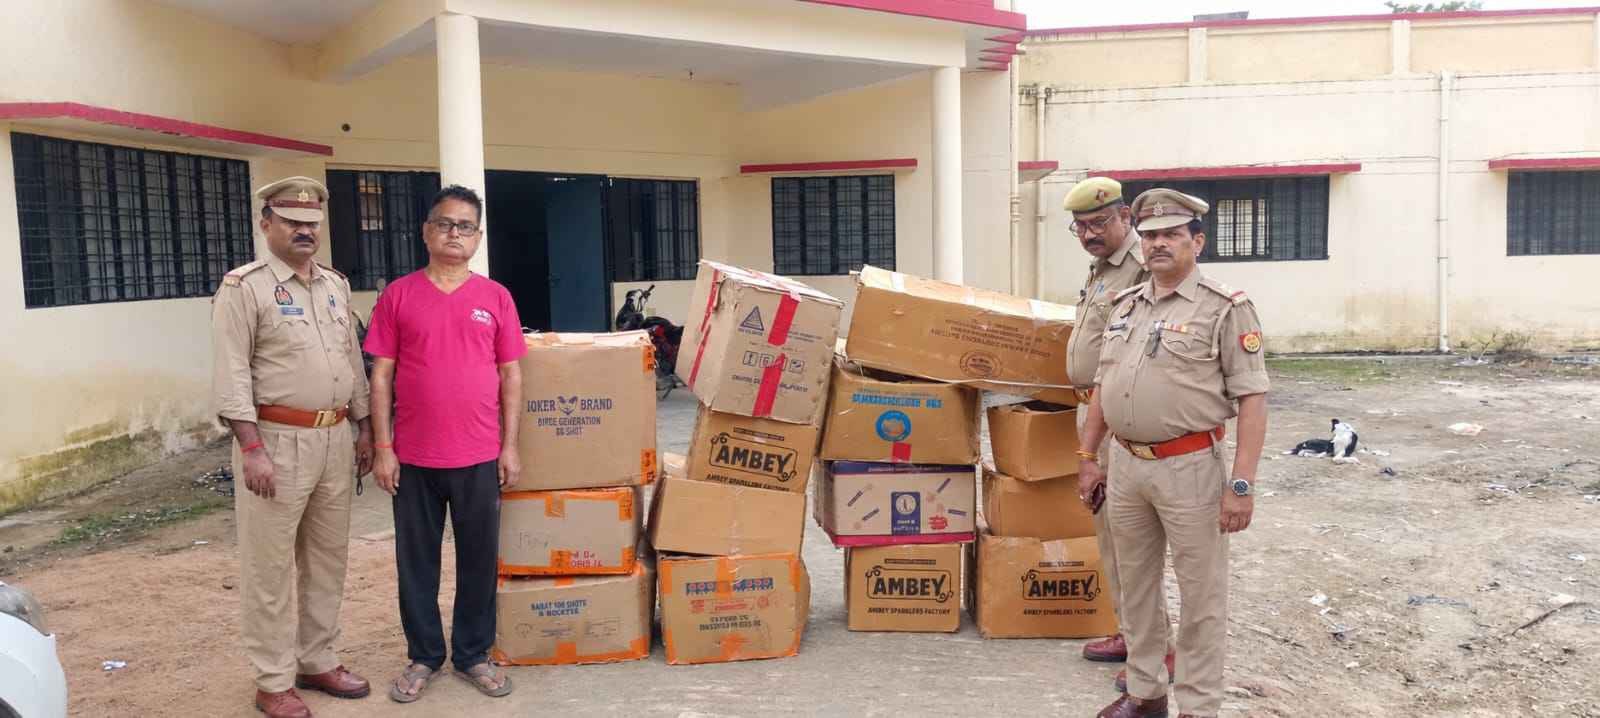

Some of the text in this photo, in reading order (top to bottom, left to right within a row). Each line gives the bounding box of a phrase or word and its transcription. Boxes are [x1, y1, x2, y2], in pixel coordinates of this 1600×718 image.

[580, 398, 613, 411] BRAND
[559, 416, 601, 426] GENERATION
[714, 445, 793, 474] AMBEY
[872, 574, 947, 596] AMBEY
[1028, 574, 1095, 597] AMBEY
